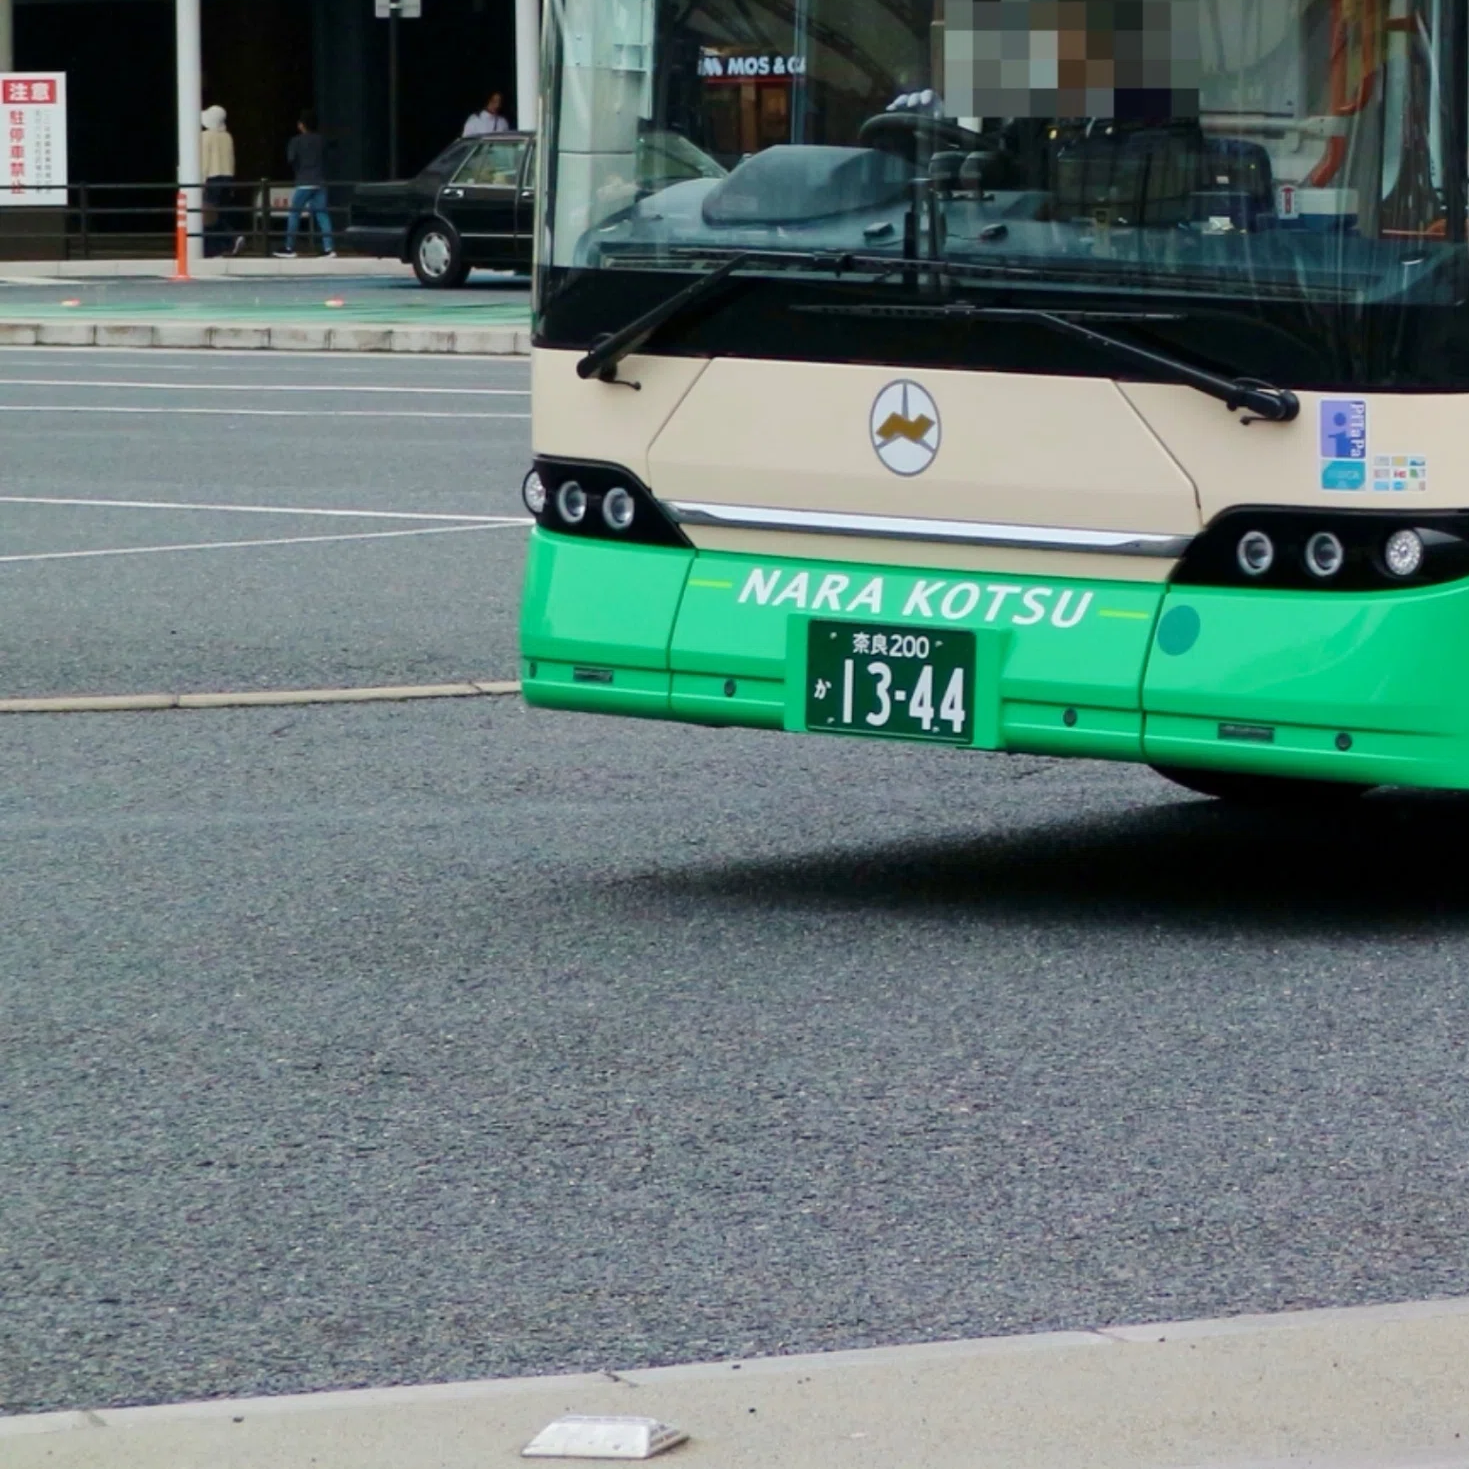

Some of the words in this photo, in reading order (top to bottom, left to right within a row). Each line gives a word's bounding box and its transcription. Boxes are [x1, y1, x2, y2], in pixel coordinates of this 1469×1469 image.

[727, 56, 770, 75] MOS
[773, 57, 785, 74] &
[8, 82, 51, 102] 注意
[9, 110, 26, 195] 駐停車禁止
[737, 568, 884, 615] NARA
[902, 580, 1094, 629] KOTSU
[852, 632, 930, 659] 奈良200
[813, 677, 833, 700] か
[842, 658, 966, 733] 13-44
